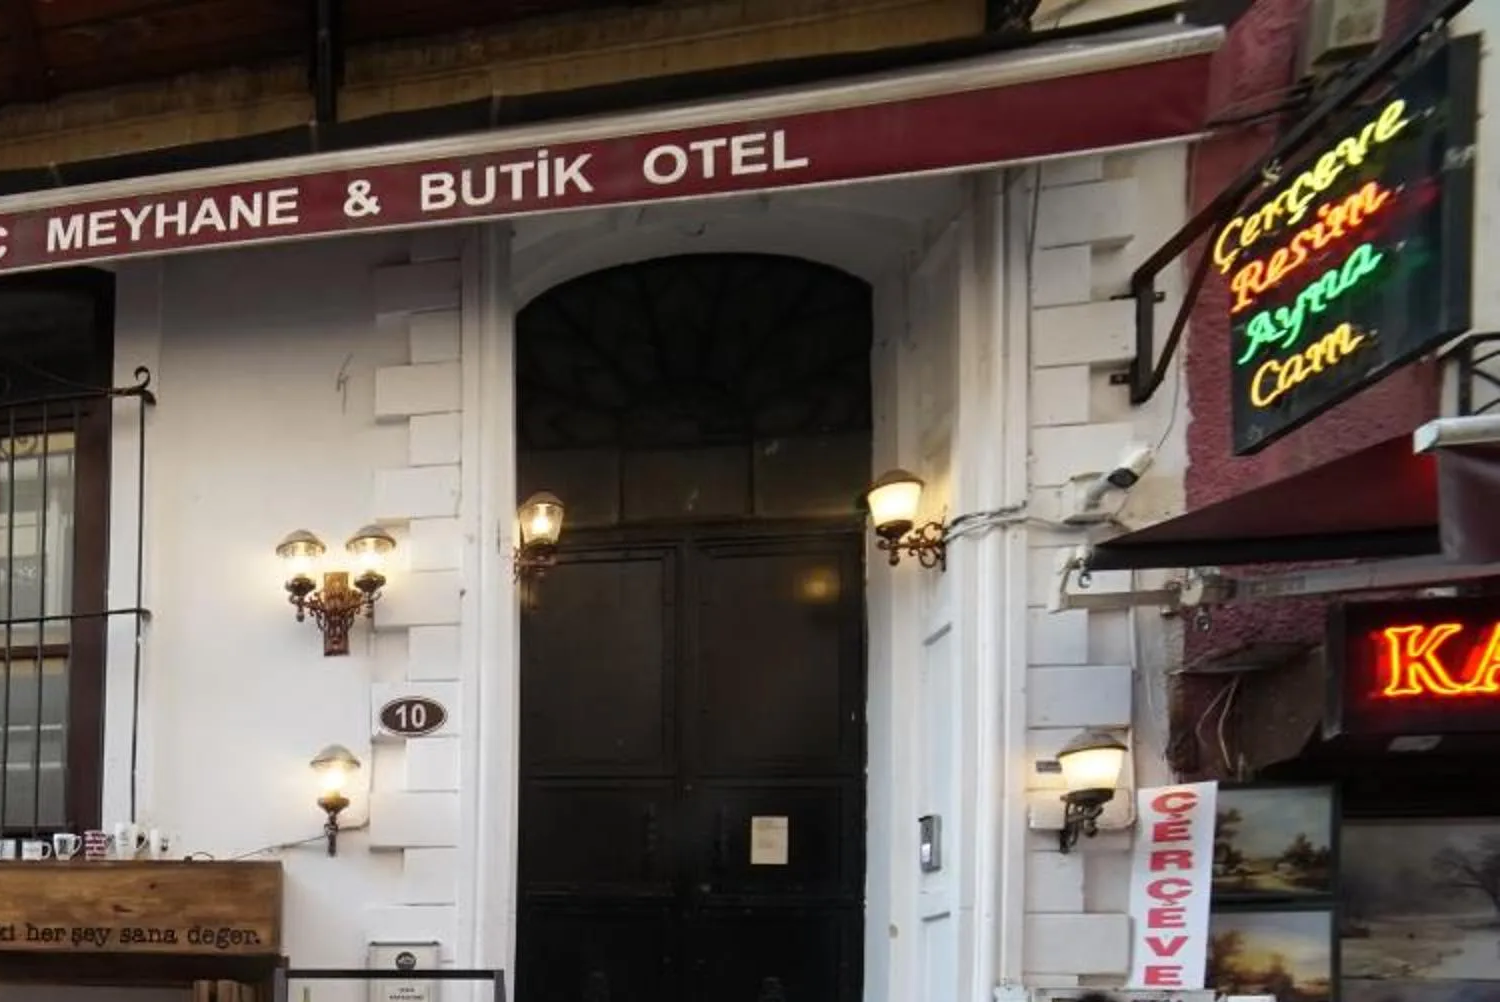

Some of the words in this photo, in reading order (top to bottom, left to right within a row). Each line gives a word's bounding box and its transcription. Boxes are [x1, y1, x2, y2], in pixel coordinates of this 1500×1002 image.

[46, 187, 300, 252] MEYHANE
[342, 179, 381, 218] &
[420, 149, 594, 212] BUTİK
[643, 129, 809, 186] OTEL
[1213, 99, 1409, 274] Çerçeve
[1230, 180, 1392, 313] Resim
[1237, 243, 1384, 365] Ayna
[1251, 321, 1364, 407] Cam
[395, 703, 426, 729] 10
[25, 922, 65, 942] her
[119, 926, 179, 944] sana
